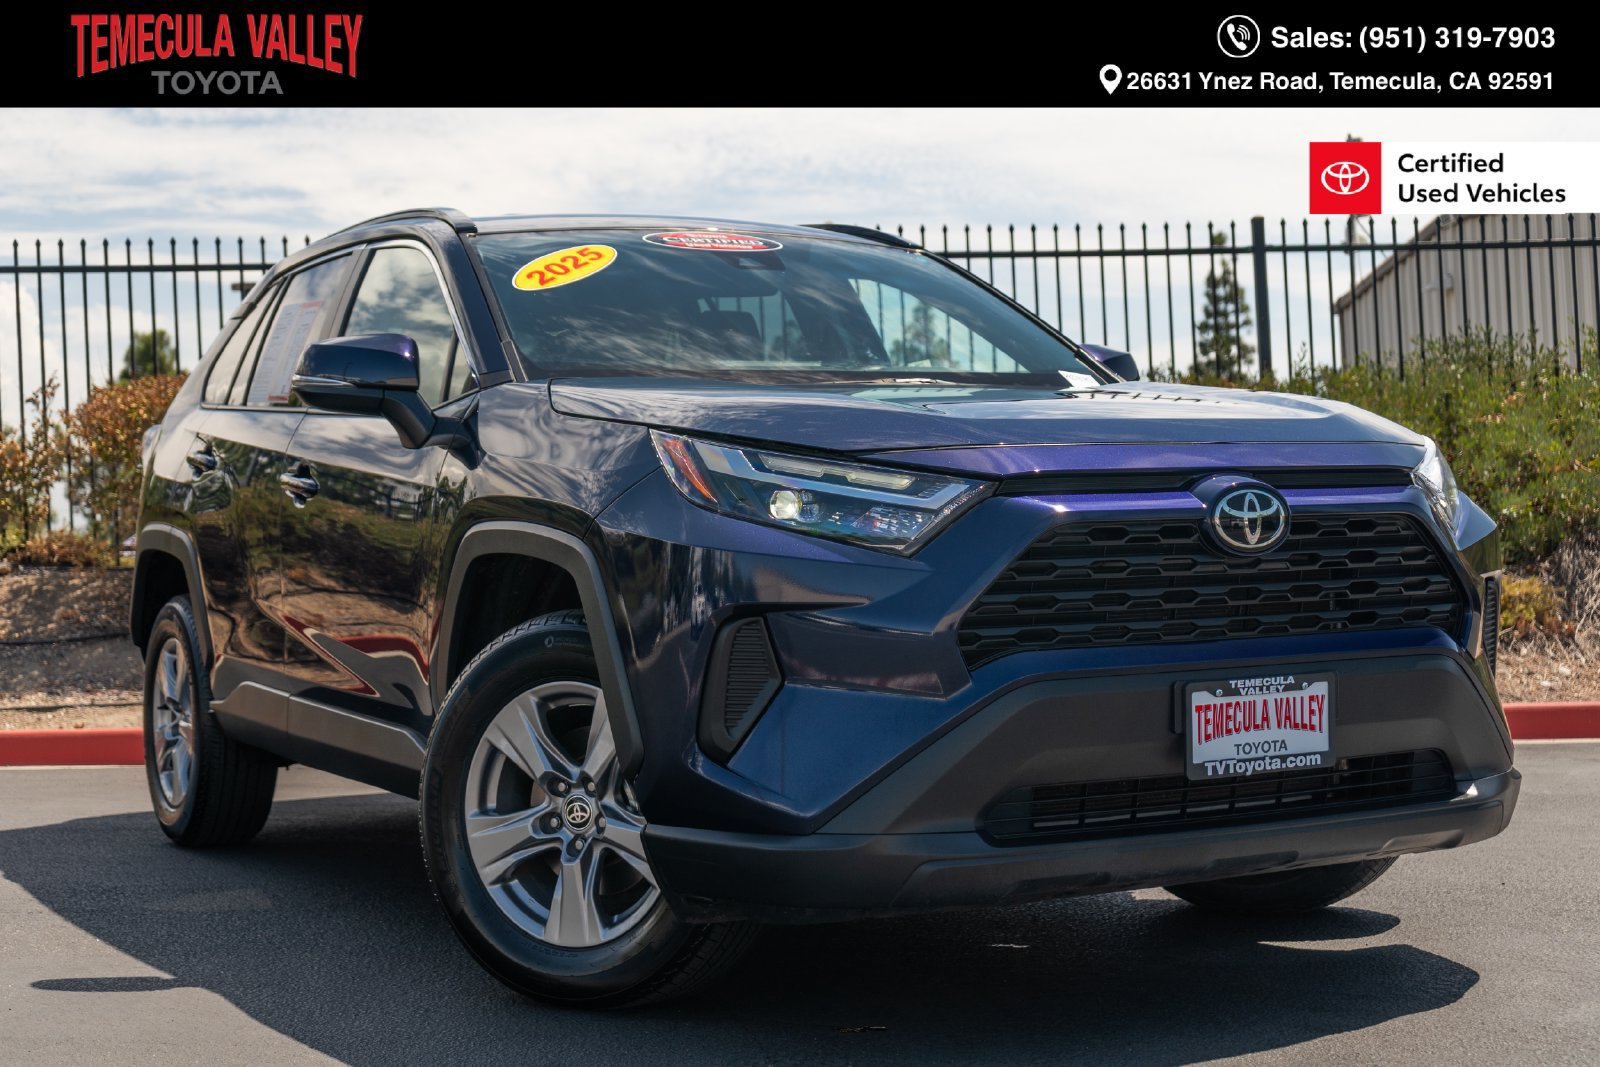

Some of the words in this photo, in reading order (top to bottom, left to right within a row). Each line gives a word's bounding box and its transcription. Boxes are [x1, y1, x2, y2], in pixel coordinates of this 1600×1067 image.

[526, 247, 602, 286] 2025
[1229, 675, 1295, 689] TEMECULA
[1239, 685, 1286, 696] VALLEY
[1195, 698, 1271, 746] TEMECULA
[1274, 694, 1326, 733] VALLEY
[1234, 739, 1288, 756] TOYOTA
[1204, 753, 1322, 776] TVToyota.com
